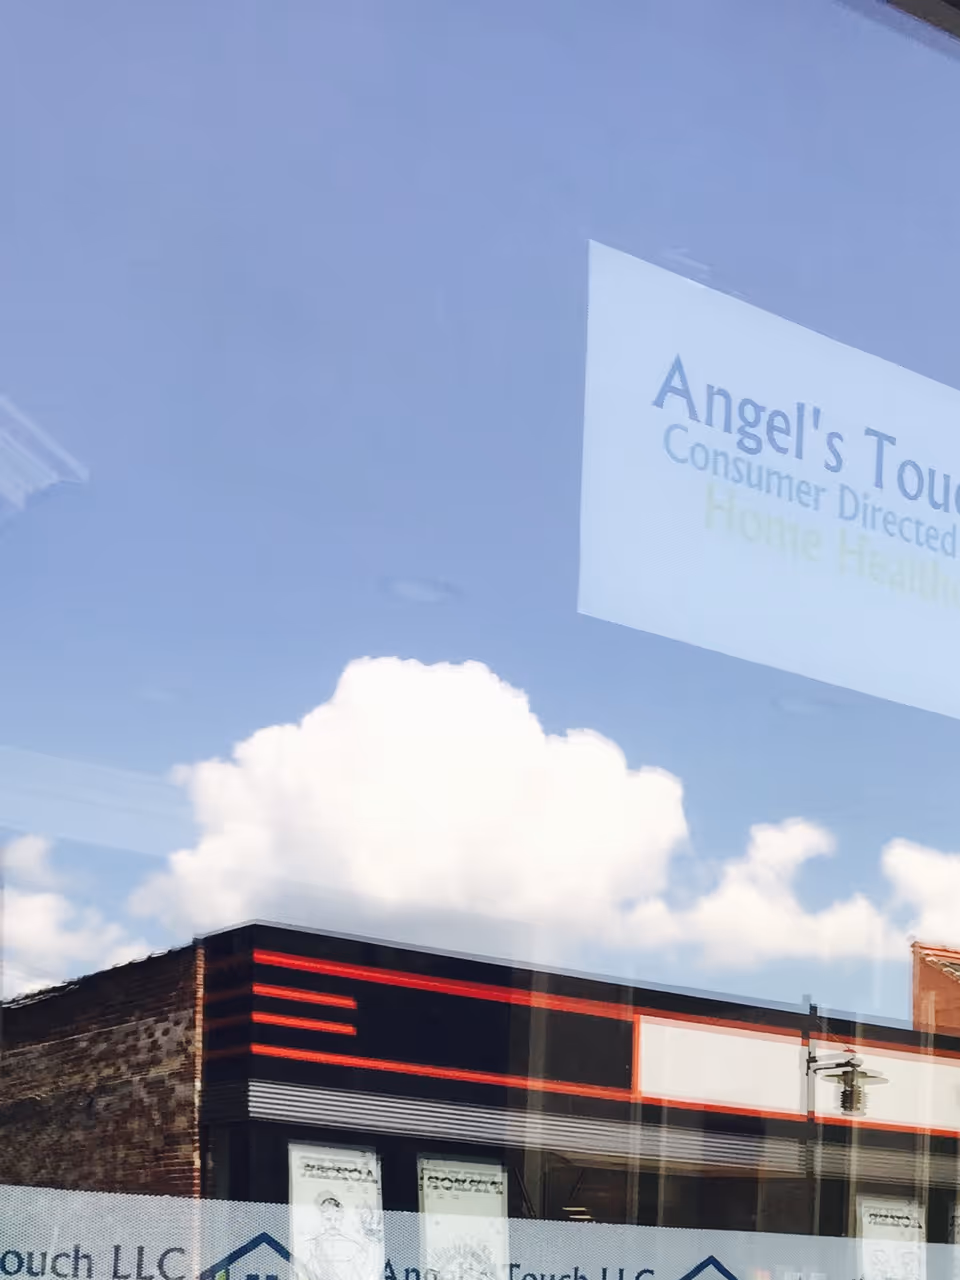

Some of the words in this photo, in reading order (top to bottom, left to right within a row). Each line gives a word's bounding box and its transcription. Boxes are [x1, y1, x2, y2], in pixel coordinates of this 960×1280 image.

[651, 353, 845, 473] Angel's
[663, 423, 827, 511] Consumer
[838, 483, 958, 559] Directed
[704, 482, 822, 562] Home
[0, 1244, 93, 1279] ouch
